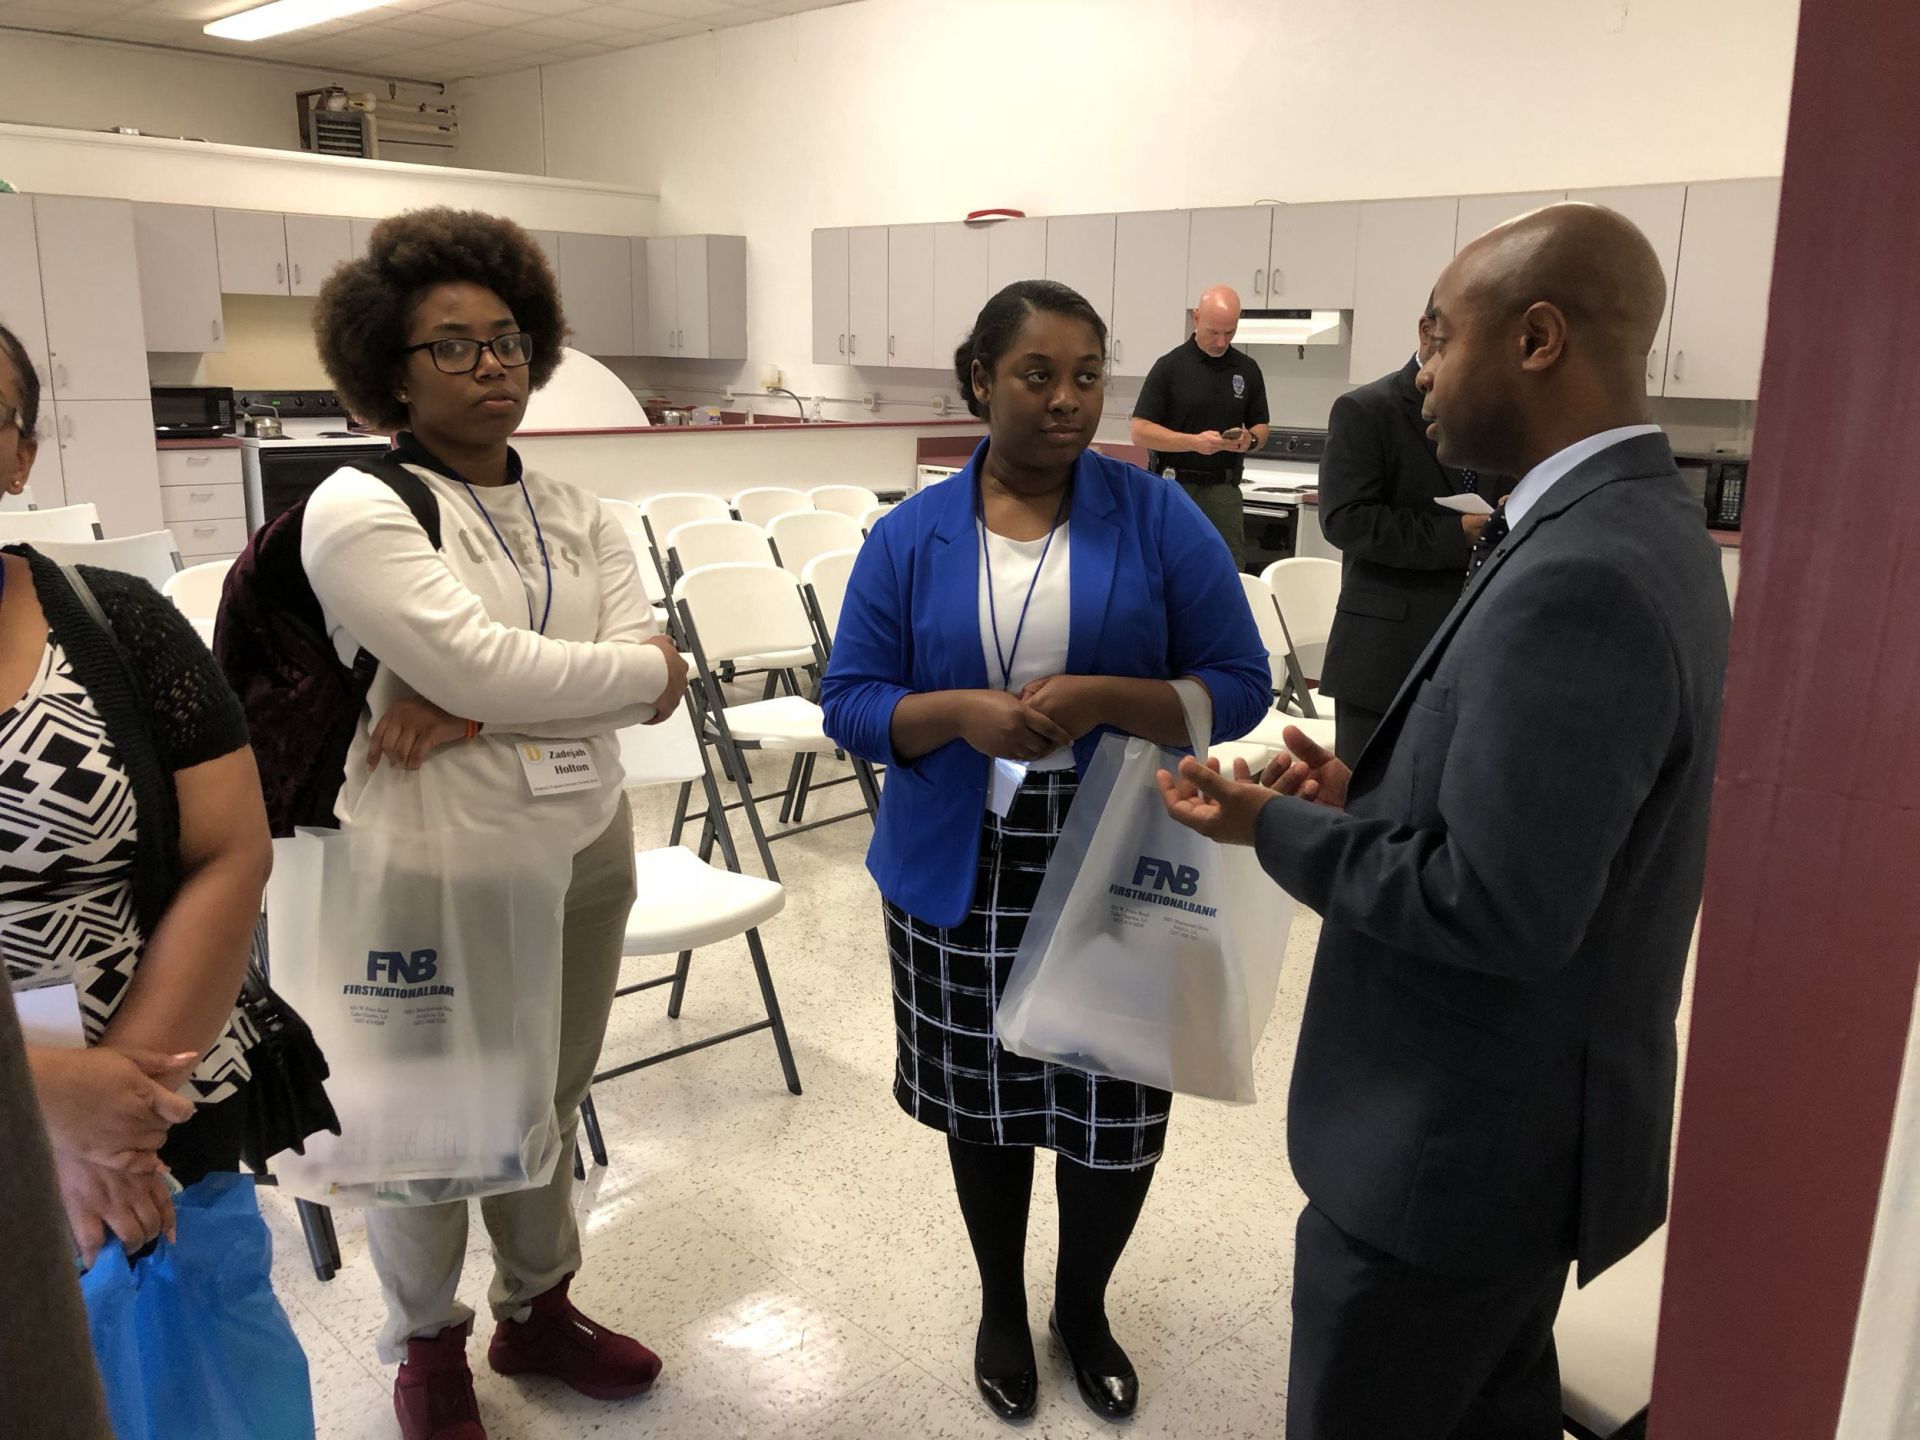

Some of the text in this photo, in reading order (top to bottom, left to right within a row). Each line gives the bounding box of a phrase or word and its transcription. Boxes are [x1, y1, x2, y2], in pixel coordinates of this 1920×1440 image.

[548, 748, 586, 760] Zadejah
[554, 763, 590, 775] Holton
[1132, 855, 1200, 896] FNB
[1109, 883, 1218, 917] FIRSTNATIONALBANK
[367, 949, 437, 984] FNB
